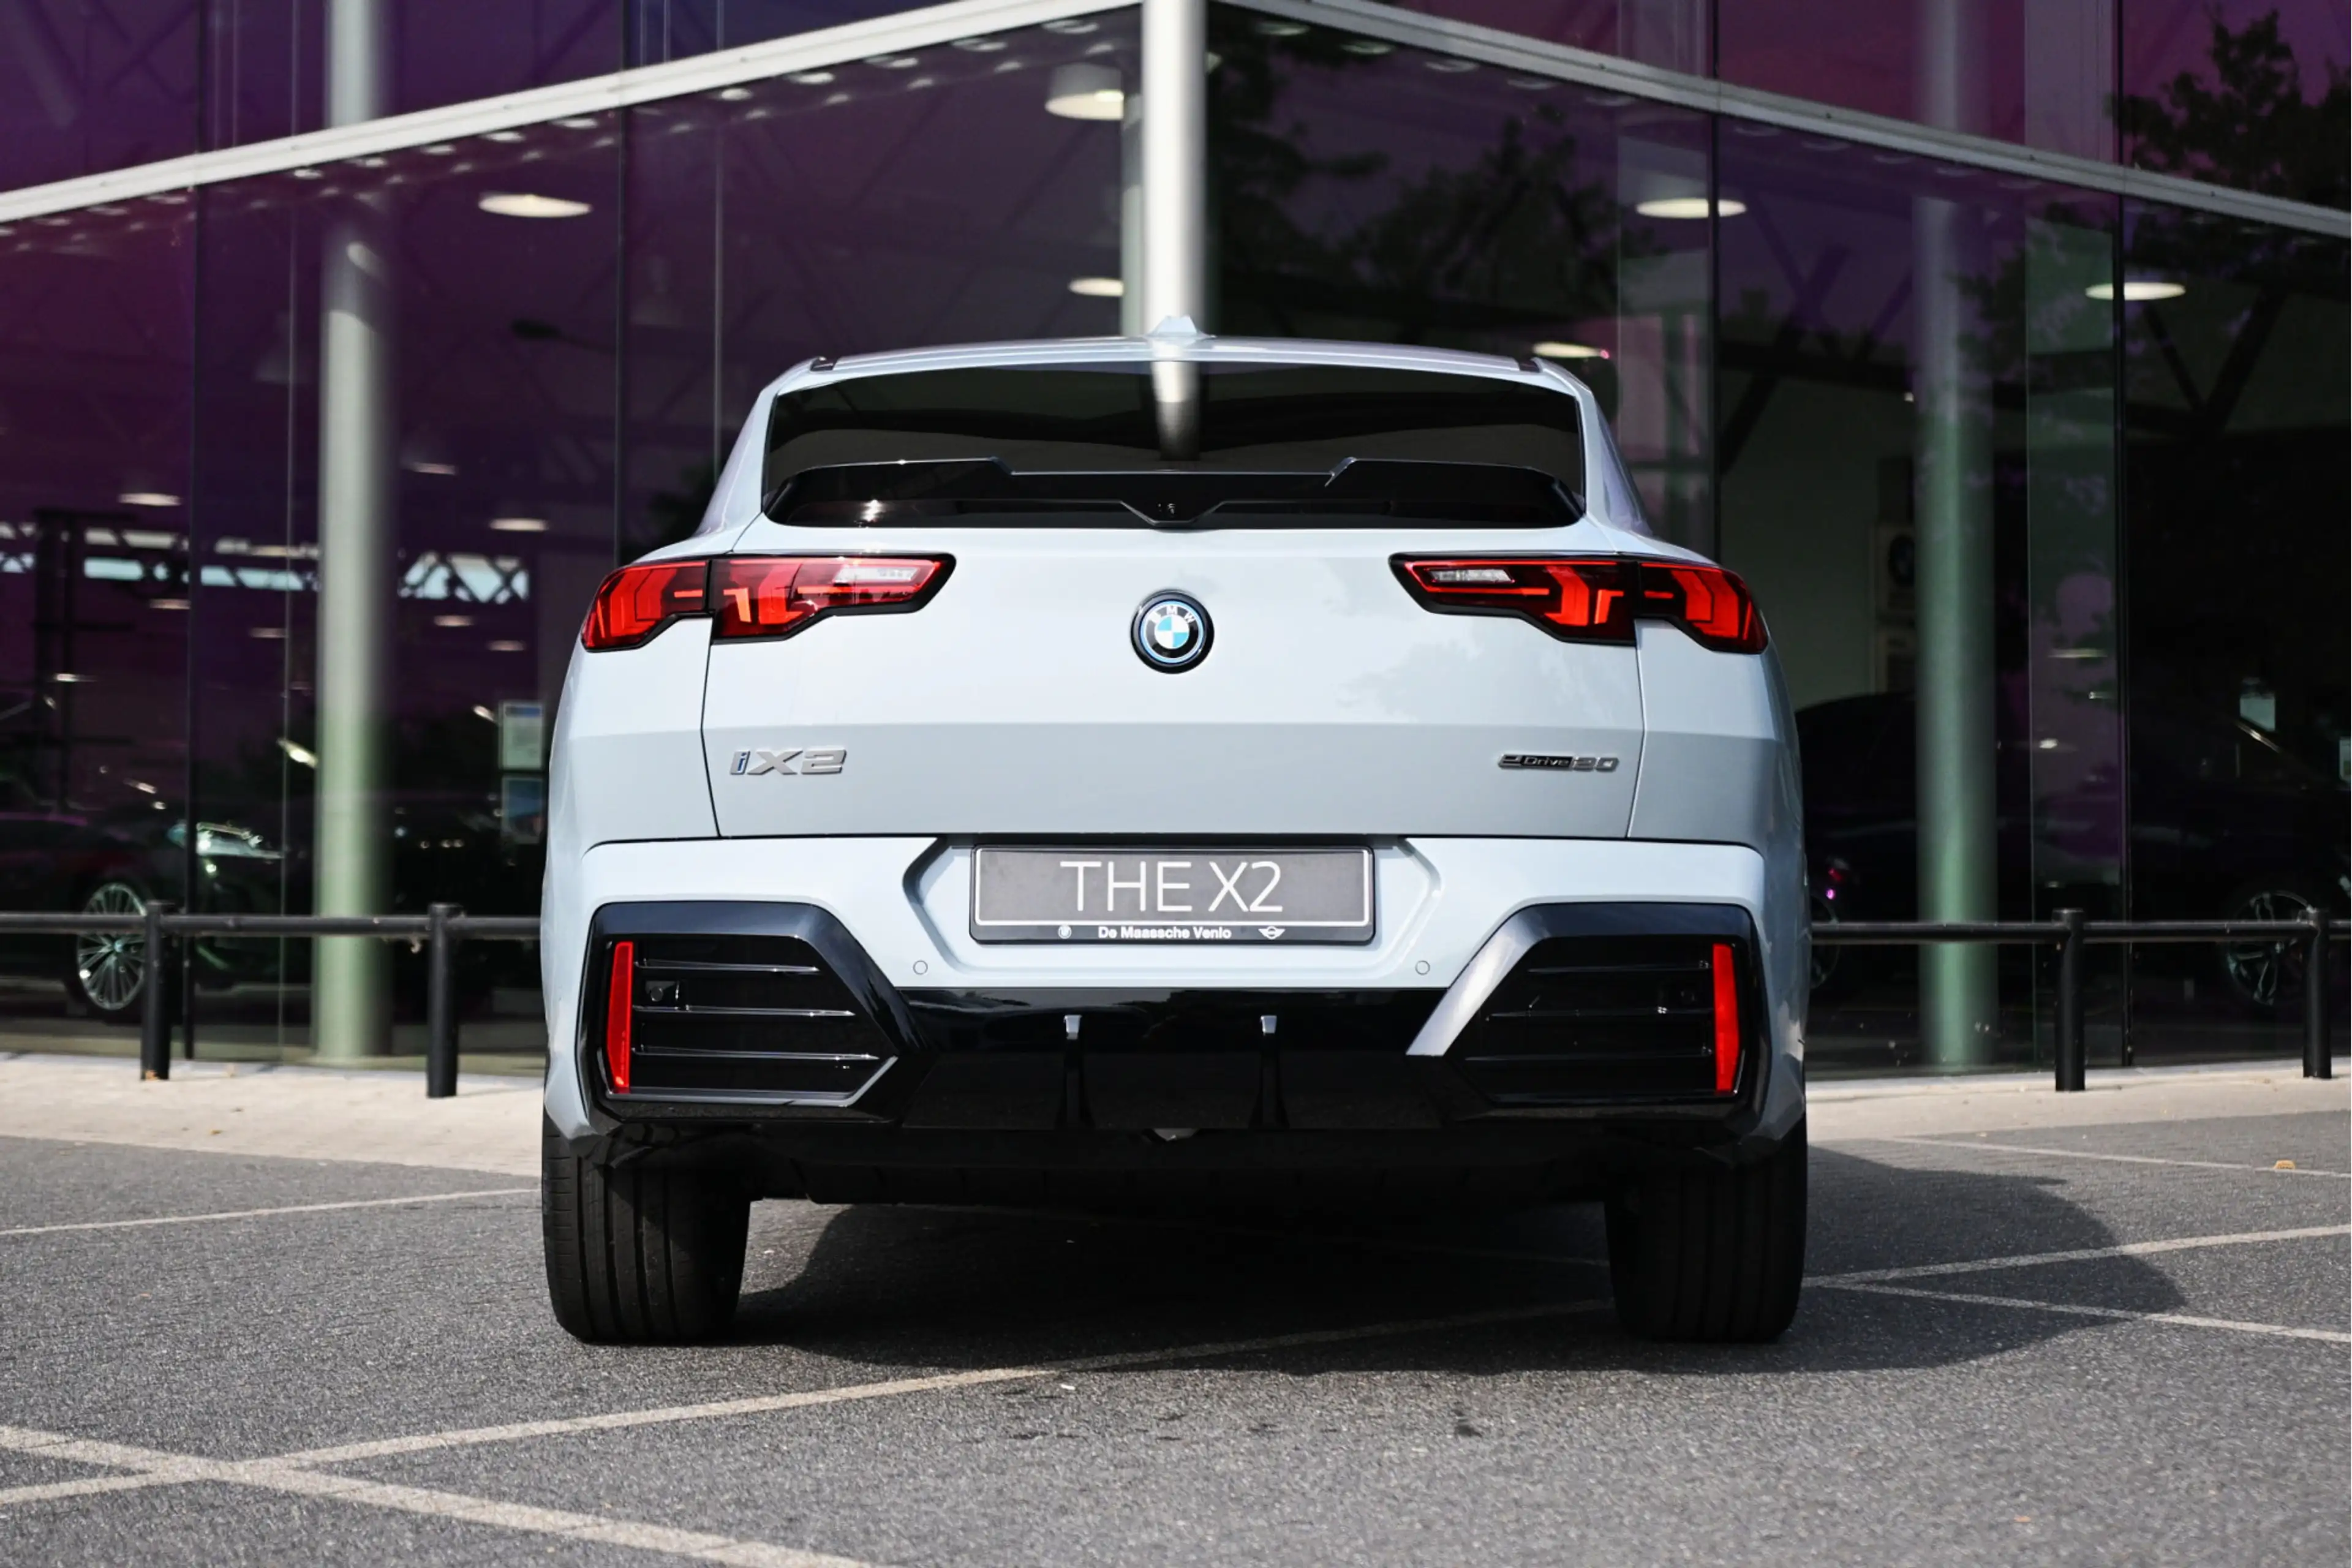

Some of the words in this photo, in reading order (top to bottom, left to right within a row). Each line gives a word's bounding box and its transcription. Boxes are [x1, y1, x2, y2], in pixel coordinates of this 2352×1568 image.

[730, 750, 846, 775] iX2
[1060, 861, 1193, 912] THE
[1208, 861, 1283, 912] X2
[1098, 926, 1118, 939] De
[1193, 926, 1232, 939] Venlo
